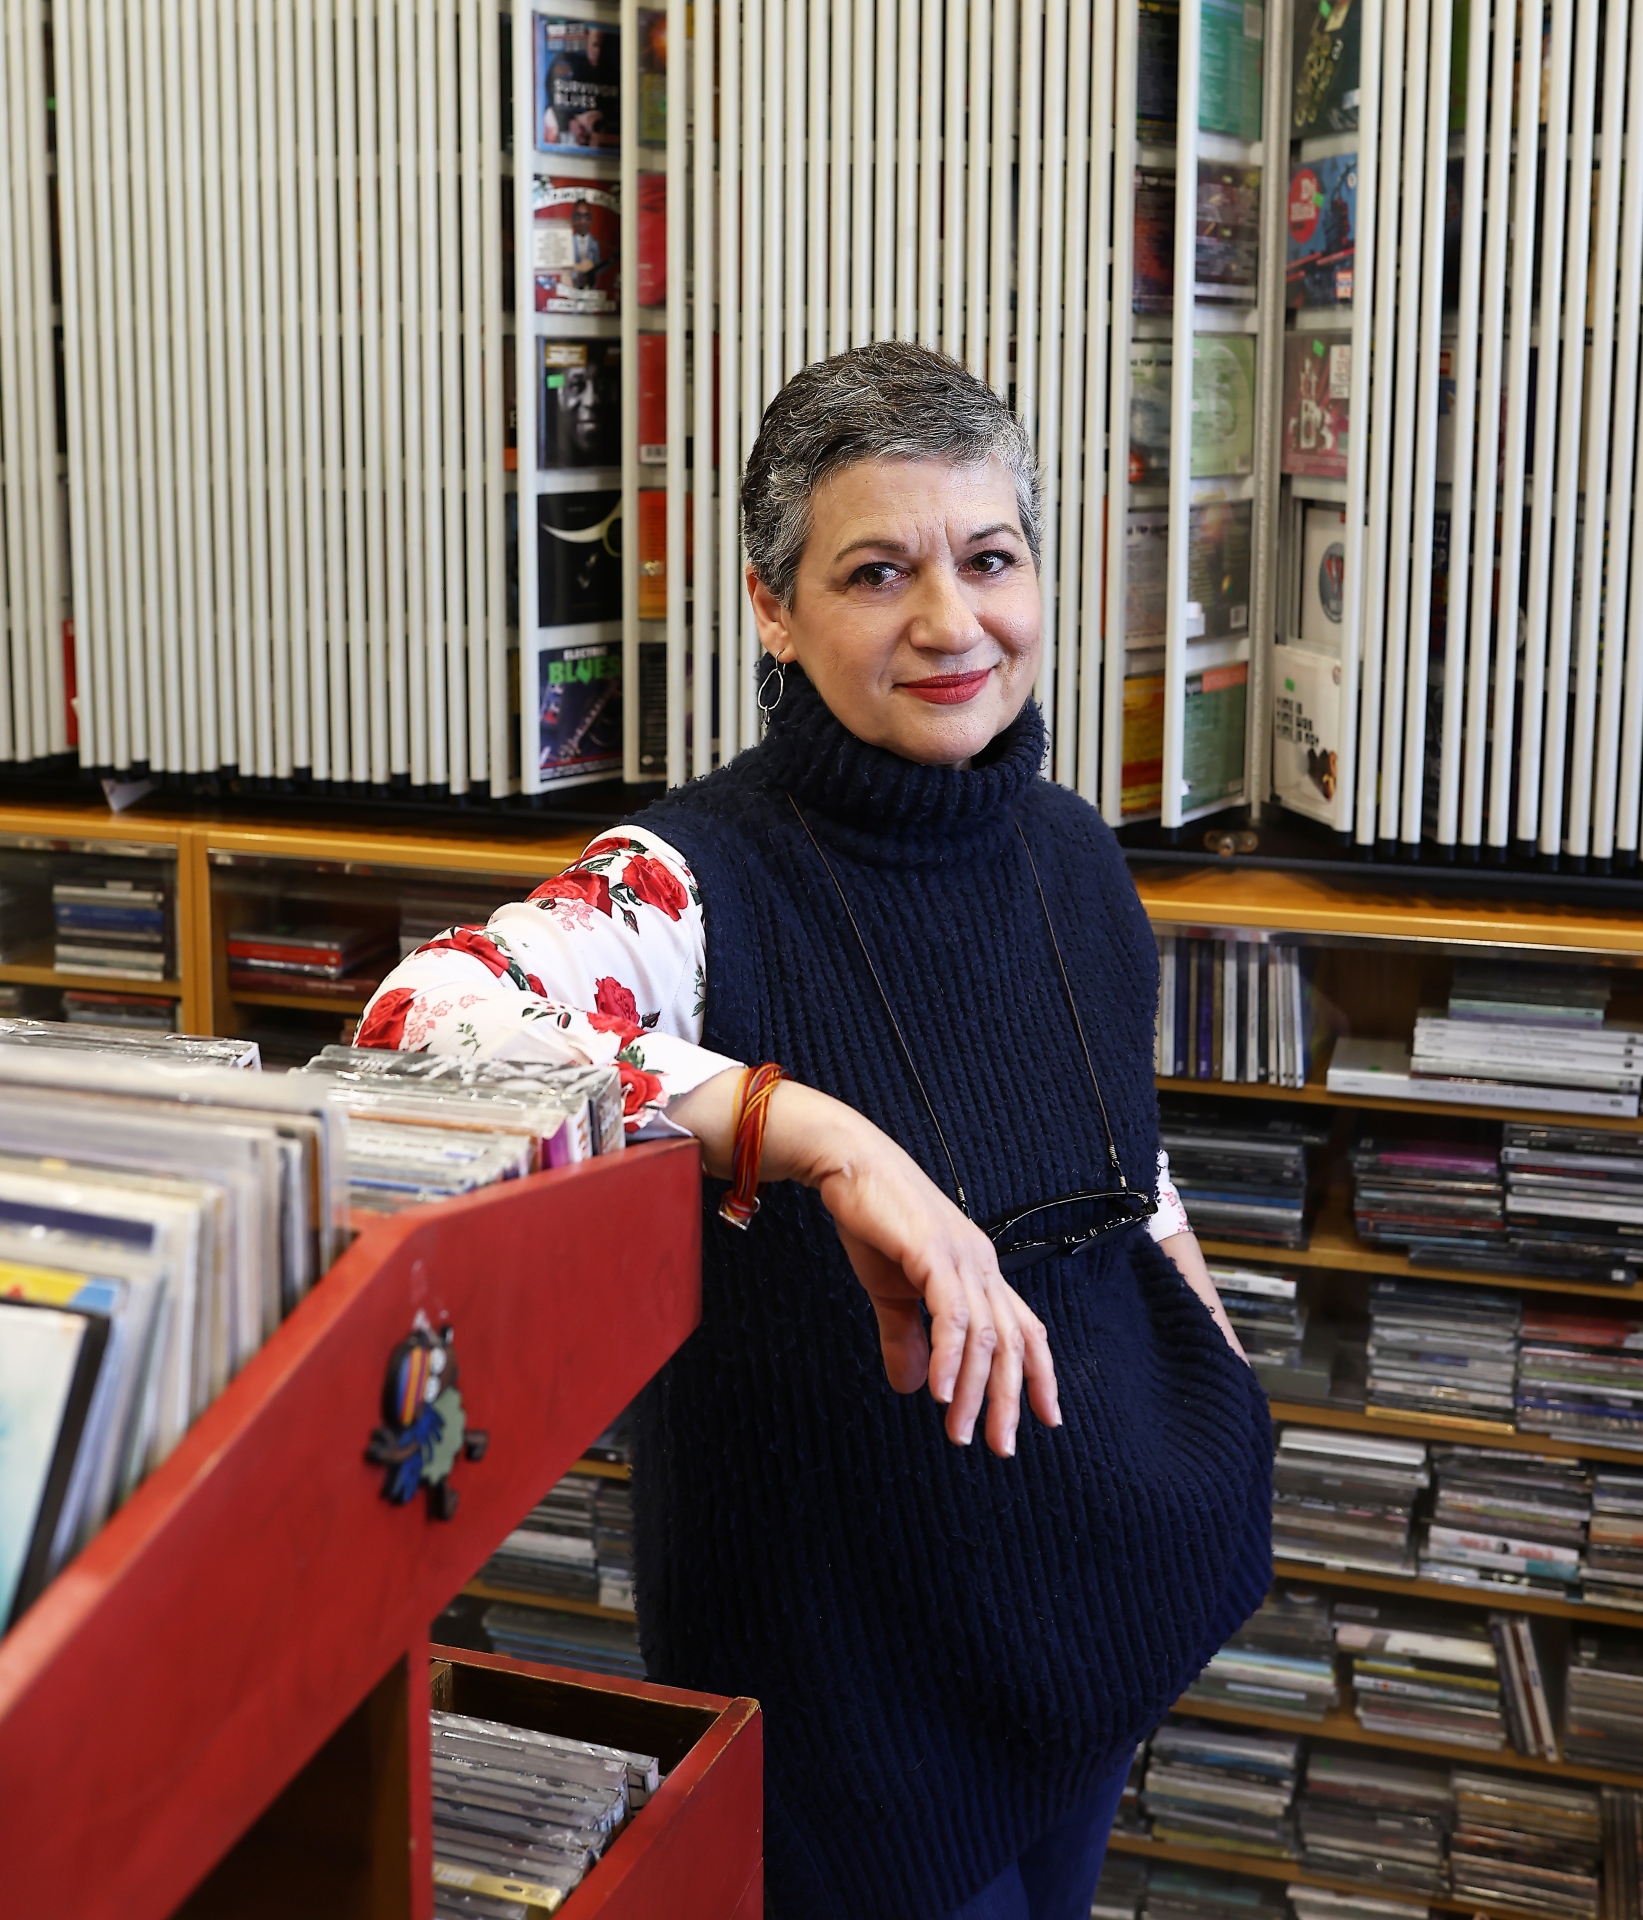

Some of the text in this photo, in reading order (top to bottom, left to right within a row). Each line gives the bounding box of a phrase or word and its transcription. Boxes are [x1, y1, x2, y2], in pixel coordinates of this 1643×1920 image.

[553, 79, 619, 97] SURVIVOR
[553, 92, 597, 108] BLUES
[563, 646, 607, 660] ELECTRIC
[548, 656, 622, 684] BLUES
